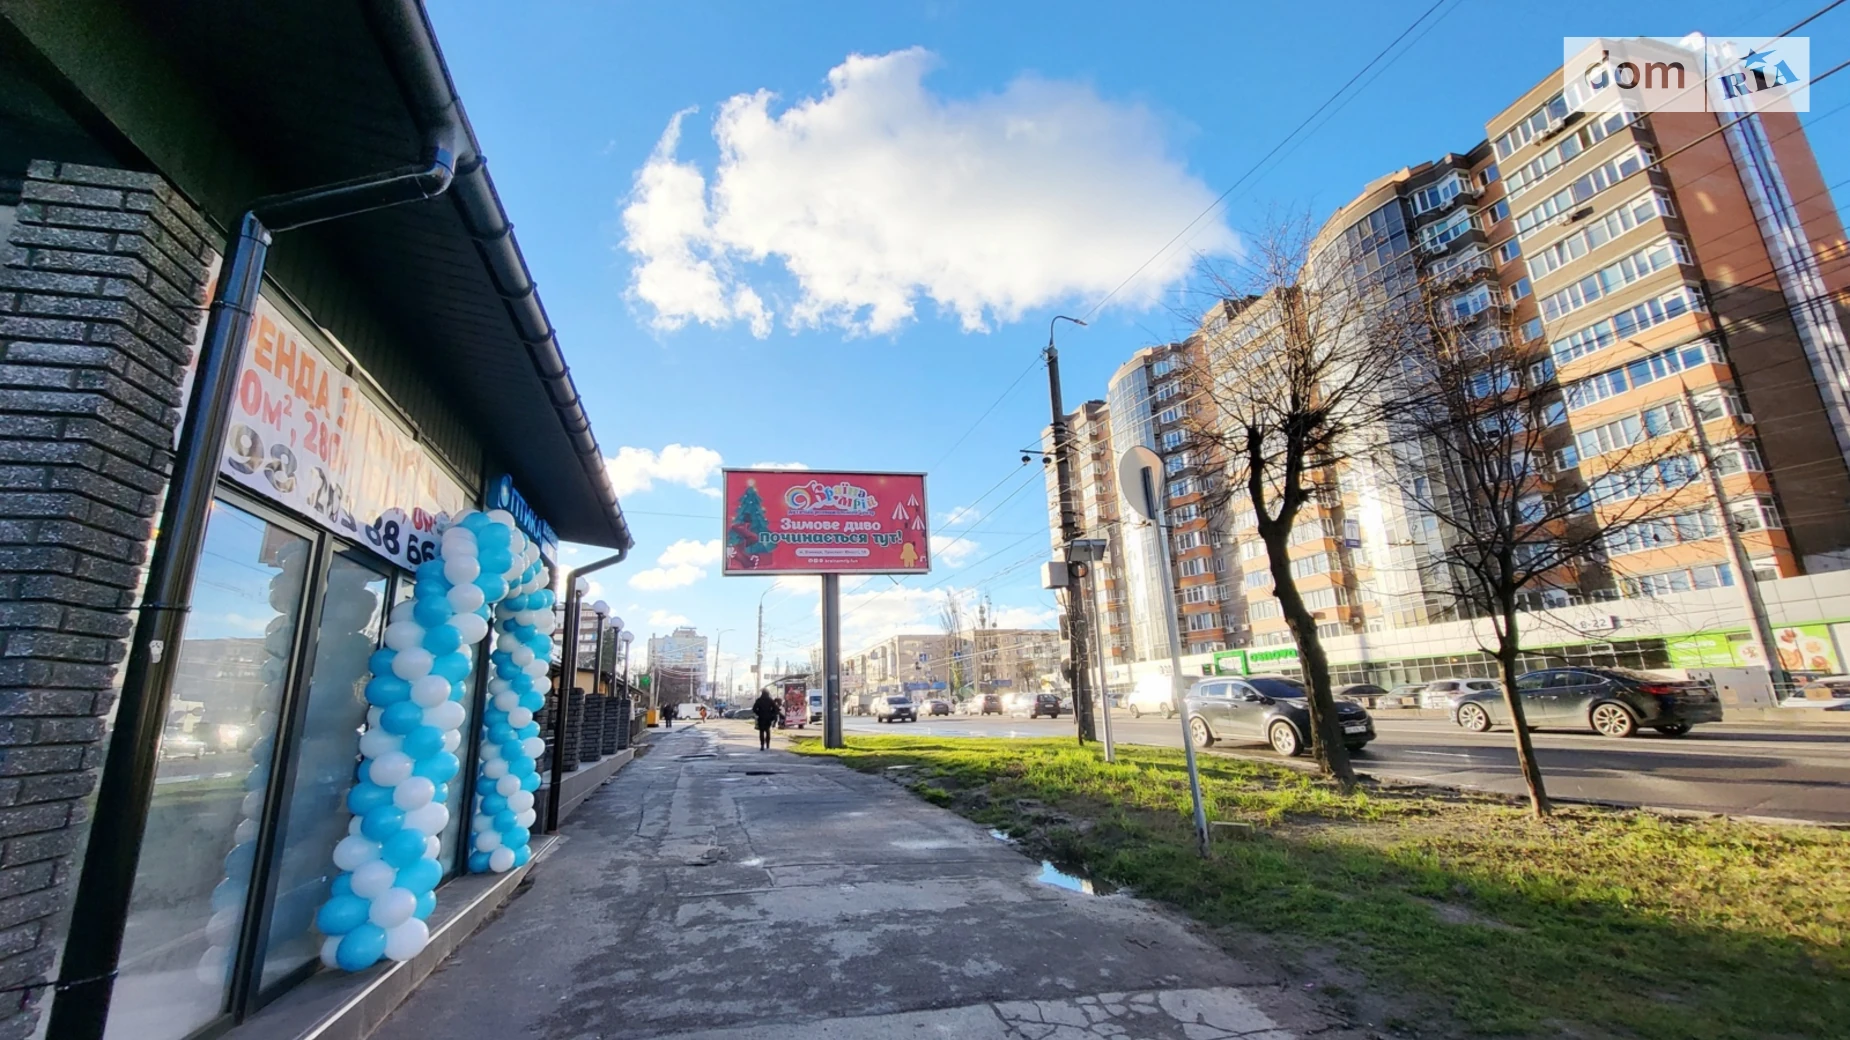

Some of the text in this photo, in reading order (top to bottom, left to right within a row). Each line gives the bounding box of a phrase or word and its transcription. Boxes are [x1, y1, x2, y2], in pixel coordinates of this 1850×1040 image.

[781, 518, 881, 532] Зимове диво
[872, 530, 903, 547] тут!
